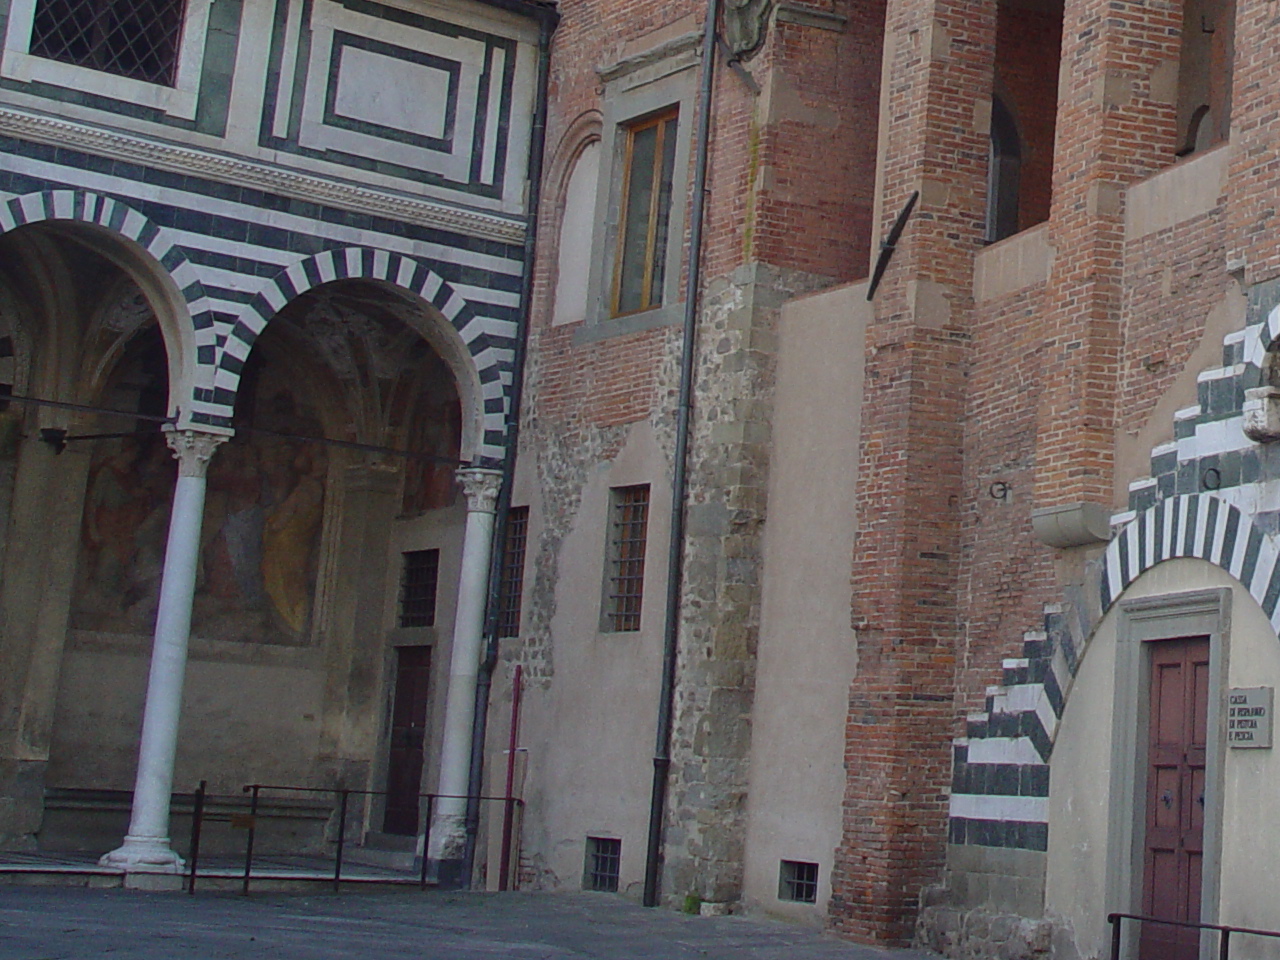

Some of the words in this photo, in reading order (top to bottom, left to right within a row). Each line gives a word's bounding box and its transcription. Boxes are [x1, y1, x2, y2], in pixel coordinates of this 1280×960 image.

[1230, 708, 1235, 717] DI
[1229, 720, 1235, 729] DI
[1229, 731, 1233, 741] E
